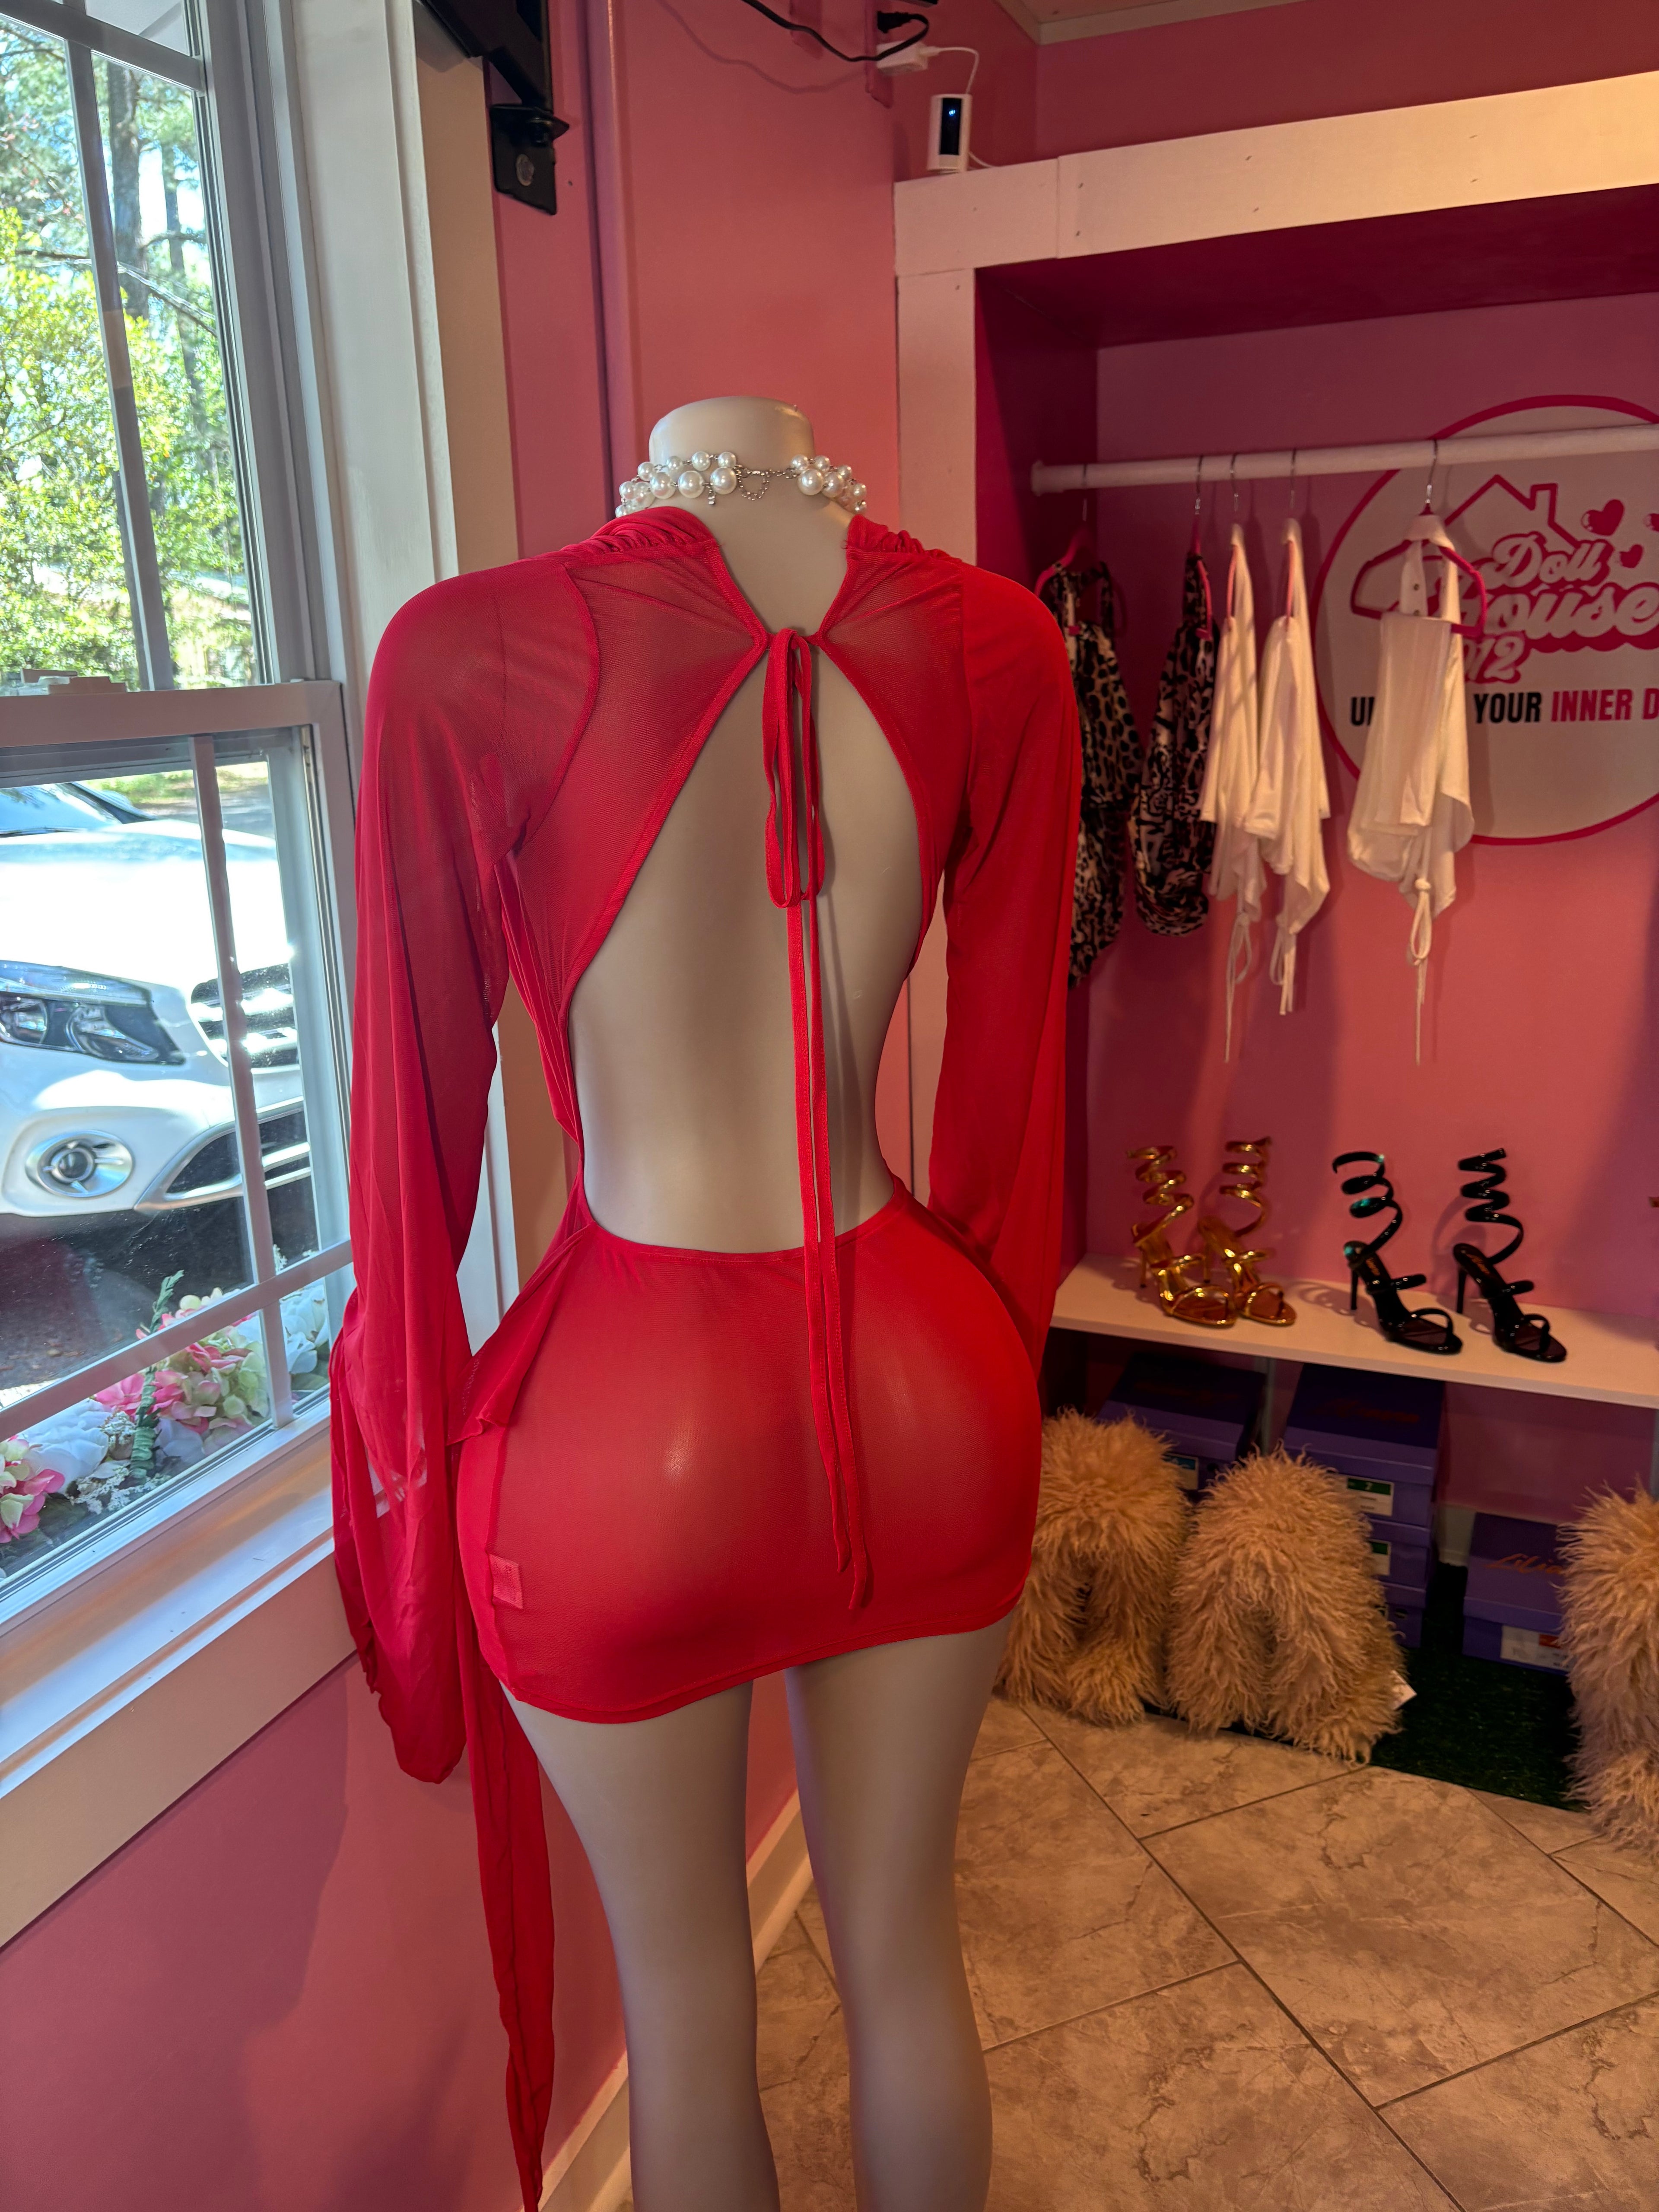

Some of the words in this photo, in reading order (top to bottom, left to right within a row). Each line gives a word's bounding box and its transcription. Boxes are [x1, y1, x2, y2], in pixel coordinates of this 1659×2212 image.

[1472, 531, 1614, 590] Doll
[1474, 692, 1542, 724] YOUR
[1551, 689, 1632, 722] INNER
